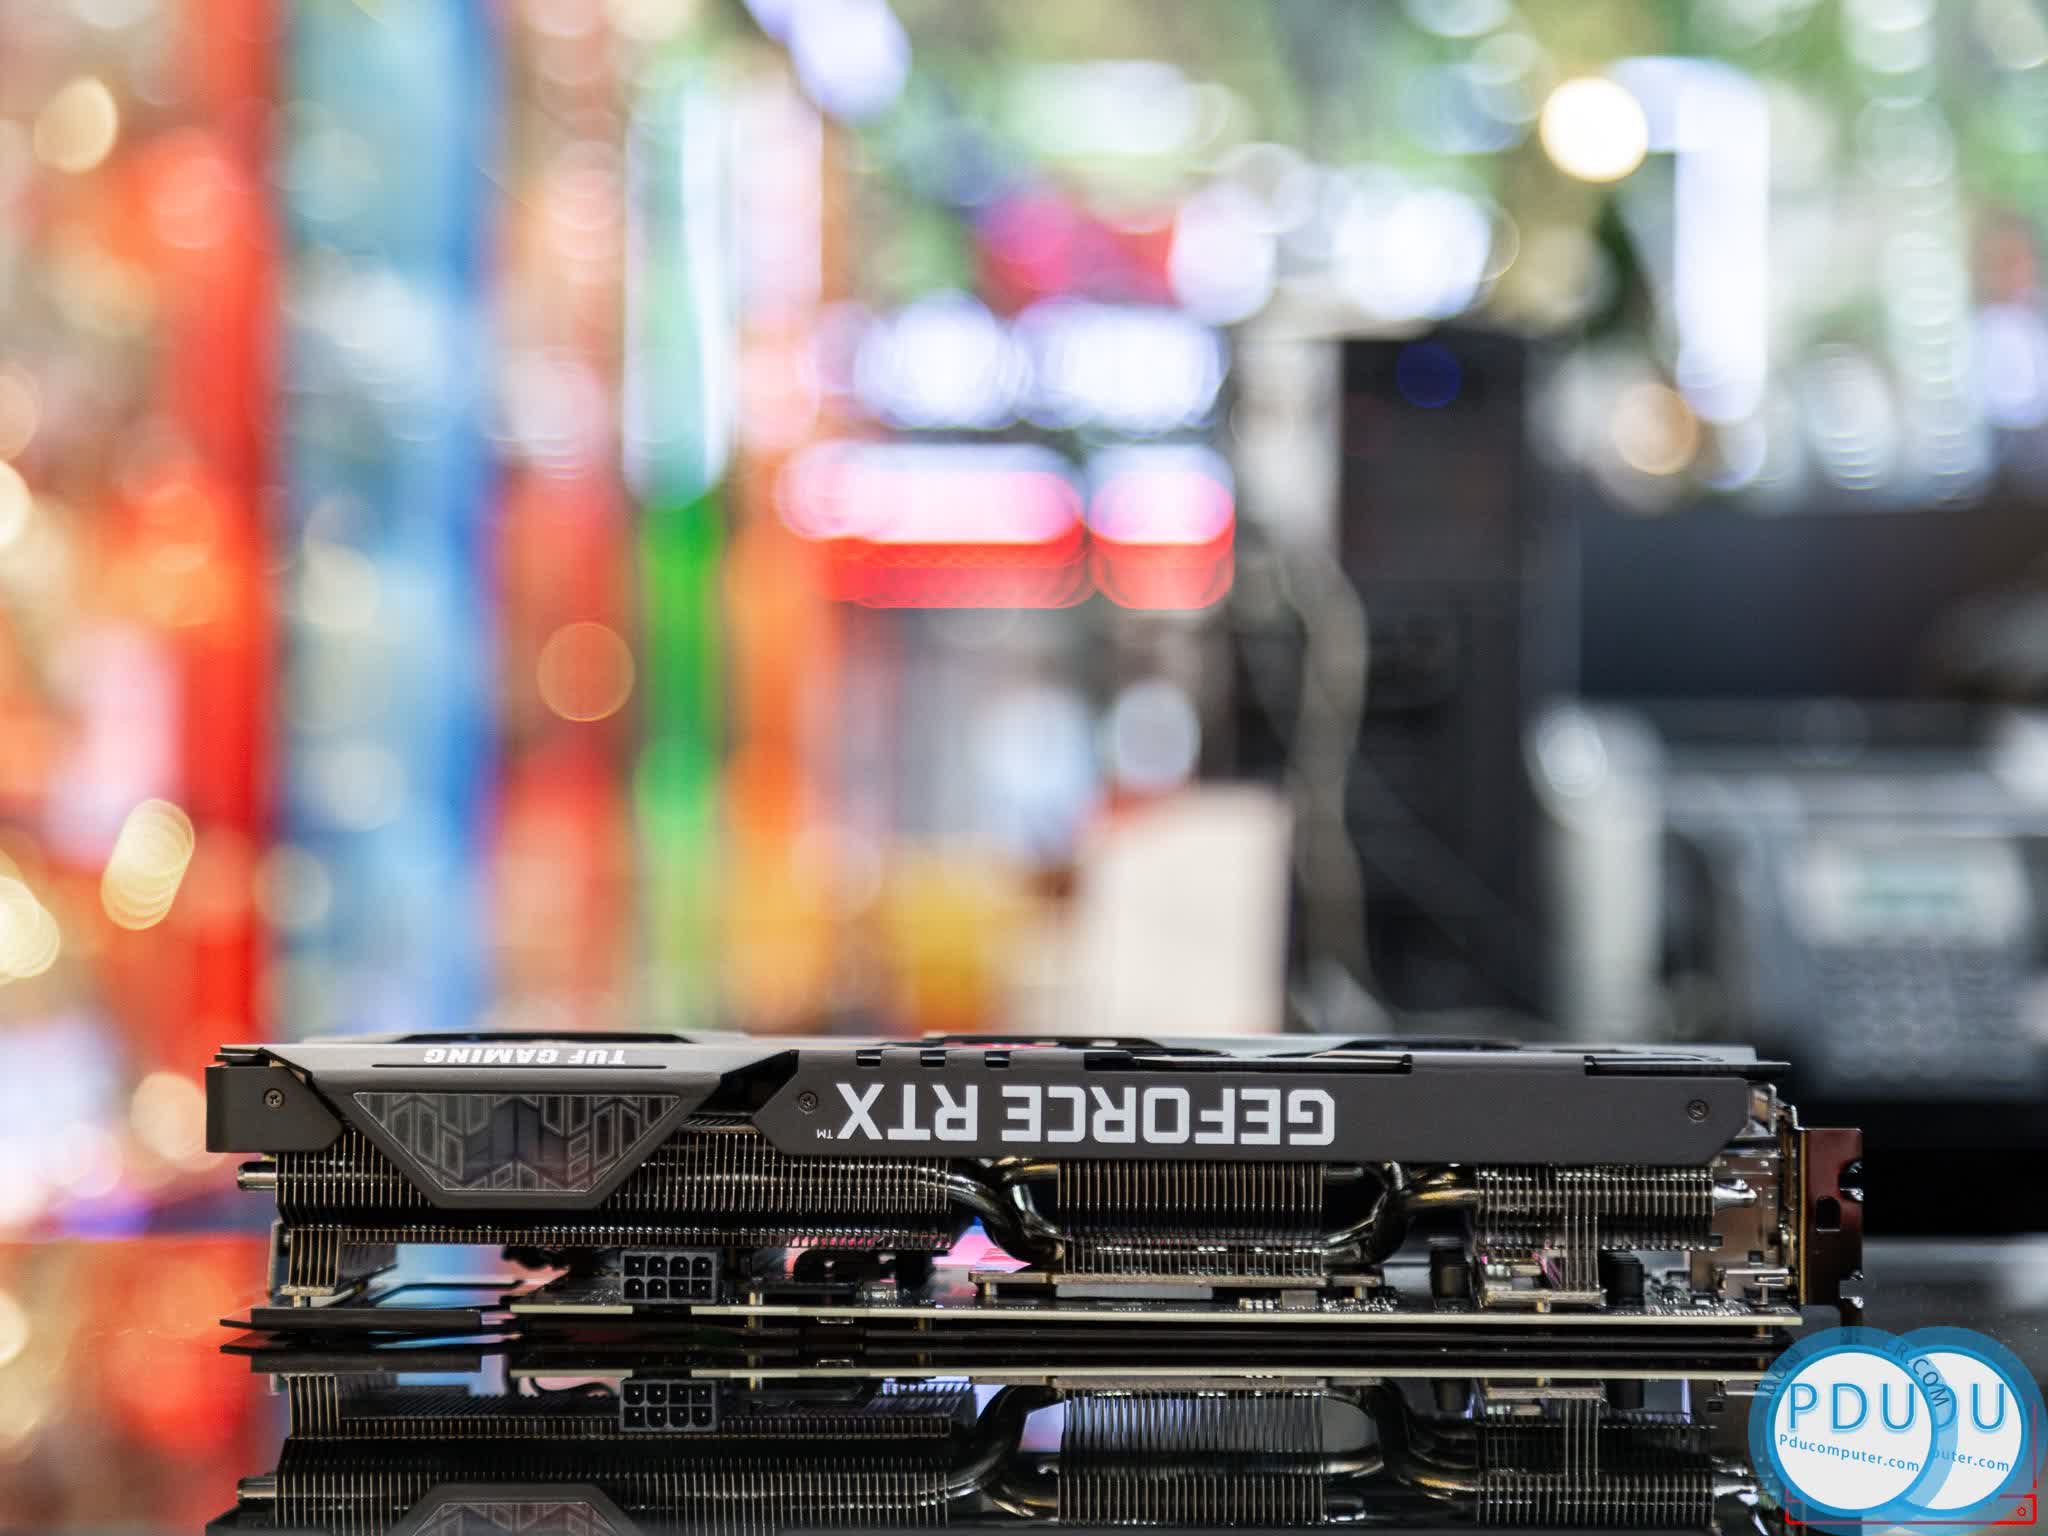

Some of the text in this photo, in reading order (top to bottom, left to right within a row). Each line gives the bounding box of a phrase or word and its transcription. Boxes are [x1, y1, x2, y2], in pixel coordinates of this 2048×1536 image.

[423, 1048, 626, 1065] TUF GAMING
[1001, 1085, 1336, 1146] GEFORCE
